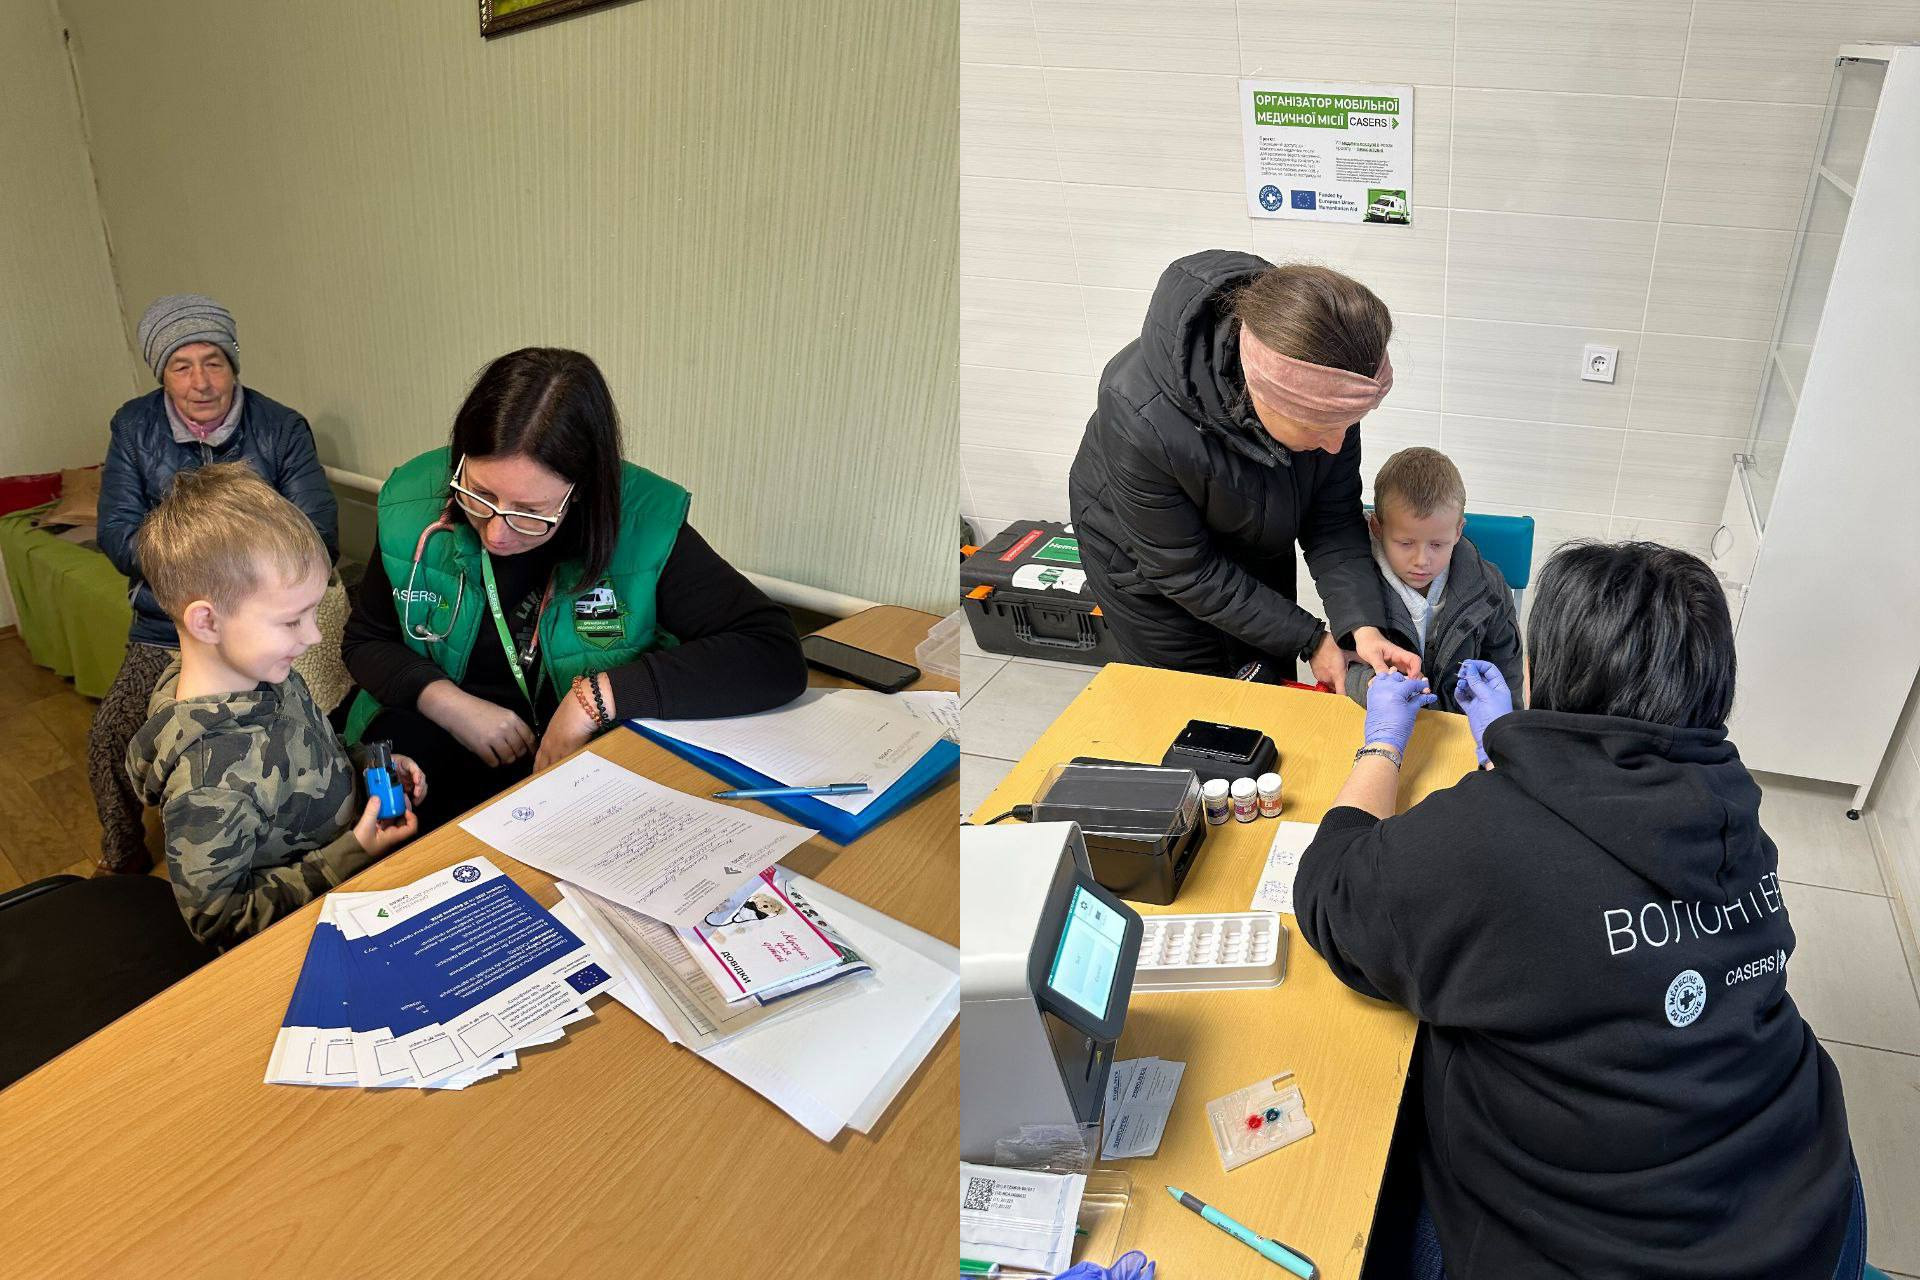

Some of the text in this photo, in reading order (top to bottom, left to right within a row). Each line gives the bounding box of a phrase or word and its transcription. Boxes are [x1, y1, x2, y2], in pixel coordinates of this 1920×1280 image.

[1256, 94, 1398, 111] ОРГАНІЗАТОР МОБІЛЬНОЇ
[1257, 112, 1344, 125] МЕДИЧНОЇ МІСІЇ
[1350, 117, 1387, 127] CASERS
[488, 584, 499, 614] CASERS
[721, 951, 751, 984] ДОВІДКИ
[1725, 955, 1775, 986] CASERS
